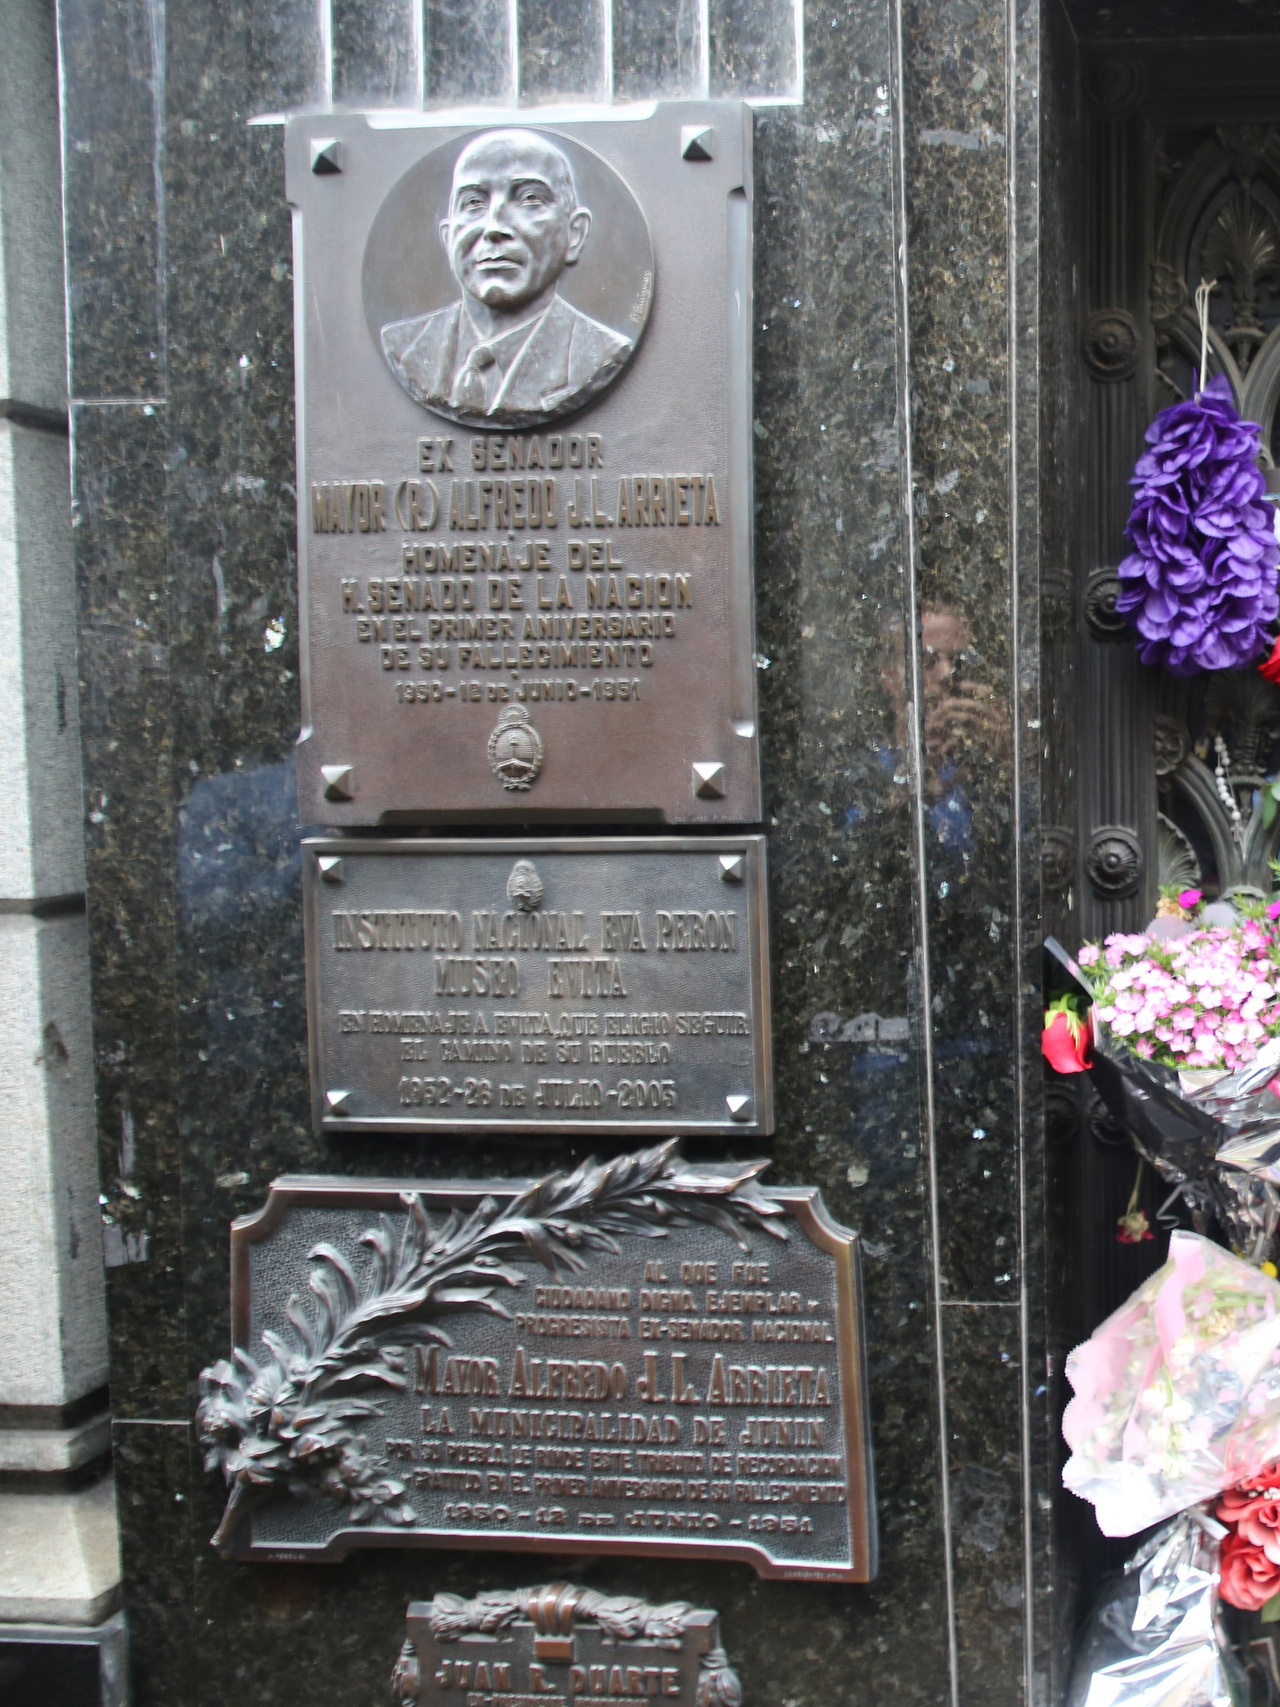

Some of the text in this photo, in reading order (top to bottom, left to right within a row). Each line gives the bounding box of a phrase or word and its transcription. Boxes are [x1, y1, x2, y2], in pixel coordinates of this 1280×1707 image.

[418, 432, 604, 472] EX SENADOR
[311, 478, 386, 534] MAYOR
[448, 477, 558, 530] ALFREDO
[617, 472, 720, 526] ARRIETA
[402, 538, 623, 573] HOMENAJE DEL
[487, 575, 523, 610] DE
[536, 574, 573, 610] LA
[585, 572, 692, 608] NACION
[356, 611, 677, 642] EN EL PRIMER ANIVERSARIO
[380, 641, 653, 671] DE SU FALLECIMIENTO
[486, 682, 510, 701] DE
[332, 909, 736, 952] INSTITUTO NACIONAL EVA PERON
[434, 955, 627, 998] MUSEO EVITA
[338, 1010, 366, 1033] EN
[368, 1010, 470, 1034] HOMENAJE
[473, 1011, 489, 1035] A
[400, 1037, 671, 1065] EL CAMINO DE SU PUEBLO
[499, 1083, 527, 1107] DE
[644, 1260, 770, 1285] AL QUE FUE
[534, 1285, 630, 1310] CIUDADANO
[706, 1290, 802, 1314] EJEMPLAR
[514, 1313, 630, 1339] PROGRESISTA
[639, 1316, 745, 1341] EX-SENADOR
[413, 1344, 500, 1397] MAYOR
[508, 1345, 627, 1400] ALFREDO
[707, 1352, 831, 1406] ARRIETA
[420, 1404, 826, 1447] LA MUNICIPALIDAD DE JUNIN
[535, 1446, 584, 1468] RINDE
[589, 1448, 632, 1471] ESTE
[636, 1450, 703, 1474] TRIBUTO
[710, 1452, 732, 1475] DE
[736, 1452, 842, 1478] RECORDACION
[486, 1470, 507, 1493] EN
[510, 1471, 531, 1494] EL
[533, 1473, 587, 1497] PRIMER
[591, 1475, 684, 1501] ANIVERSARIO
[687, 1479, 709, 1501] DE
[711, 1480, 731, 1501] SU
[732, 1480, 847, 1504] FALLECIMIENTO
[624, 1509, 720, 1530] JUNIO
[435, 1658, 512, 1692] JUAN
[570, 1663, 681, 1697] DUARTE
